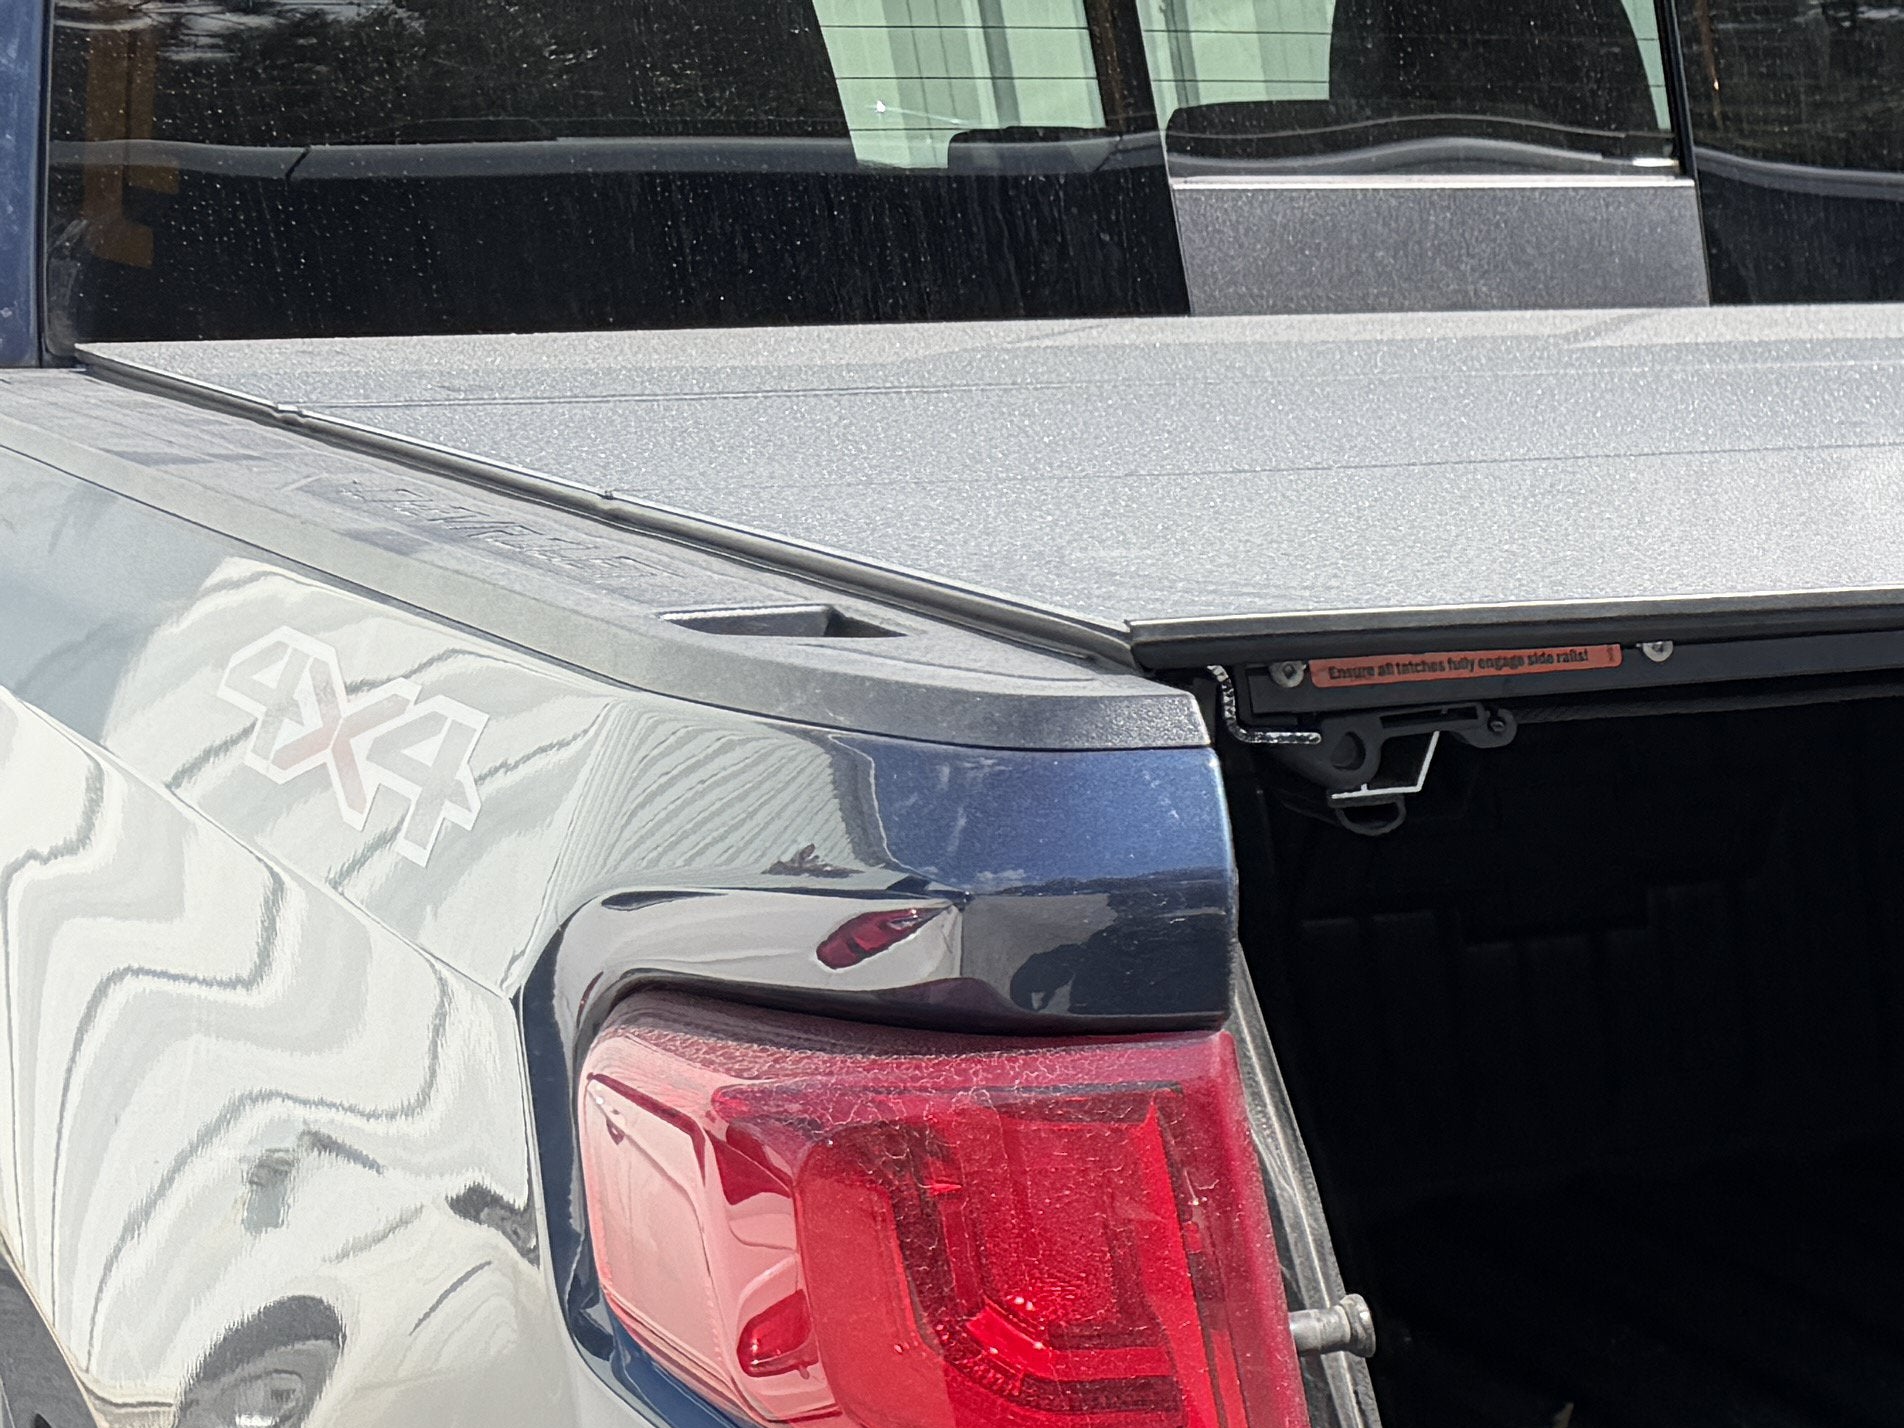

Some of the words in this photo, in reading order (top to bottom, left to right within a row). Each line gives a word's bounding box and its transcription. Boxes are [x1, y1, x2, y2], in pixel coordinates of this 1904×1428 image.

[1328, 665, 1375, 679] Ensure
[1378, 662, 1395, 676] all
[1396, 660, 1446, 674] latches
[1447, 657, 1476, 673] fully
[1478, 654, 1525, 671] engage
[1527, 651, 1554, 666] side
[1556, 648, 1589, 663] rails!
